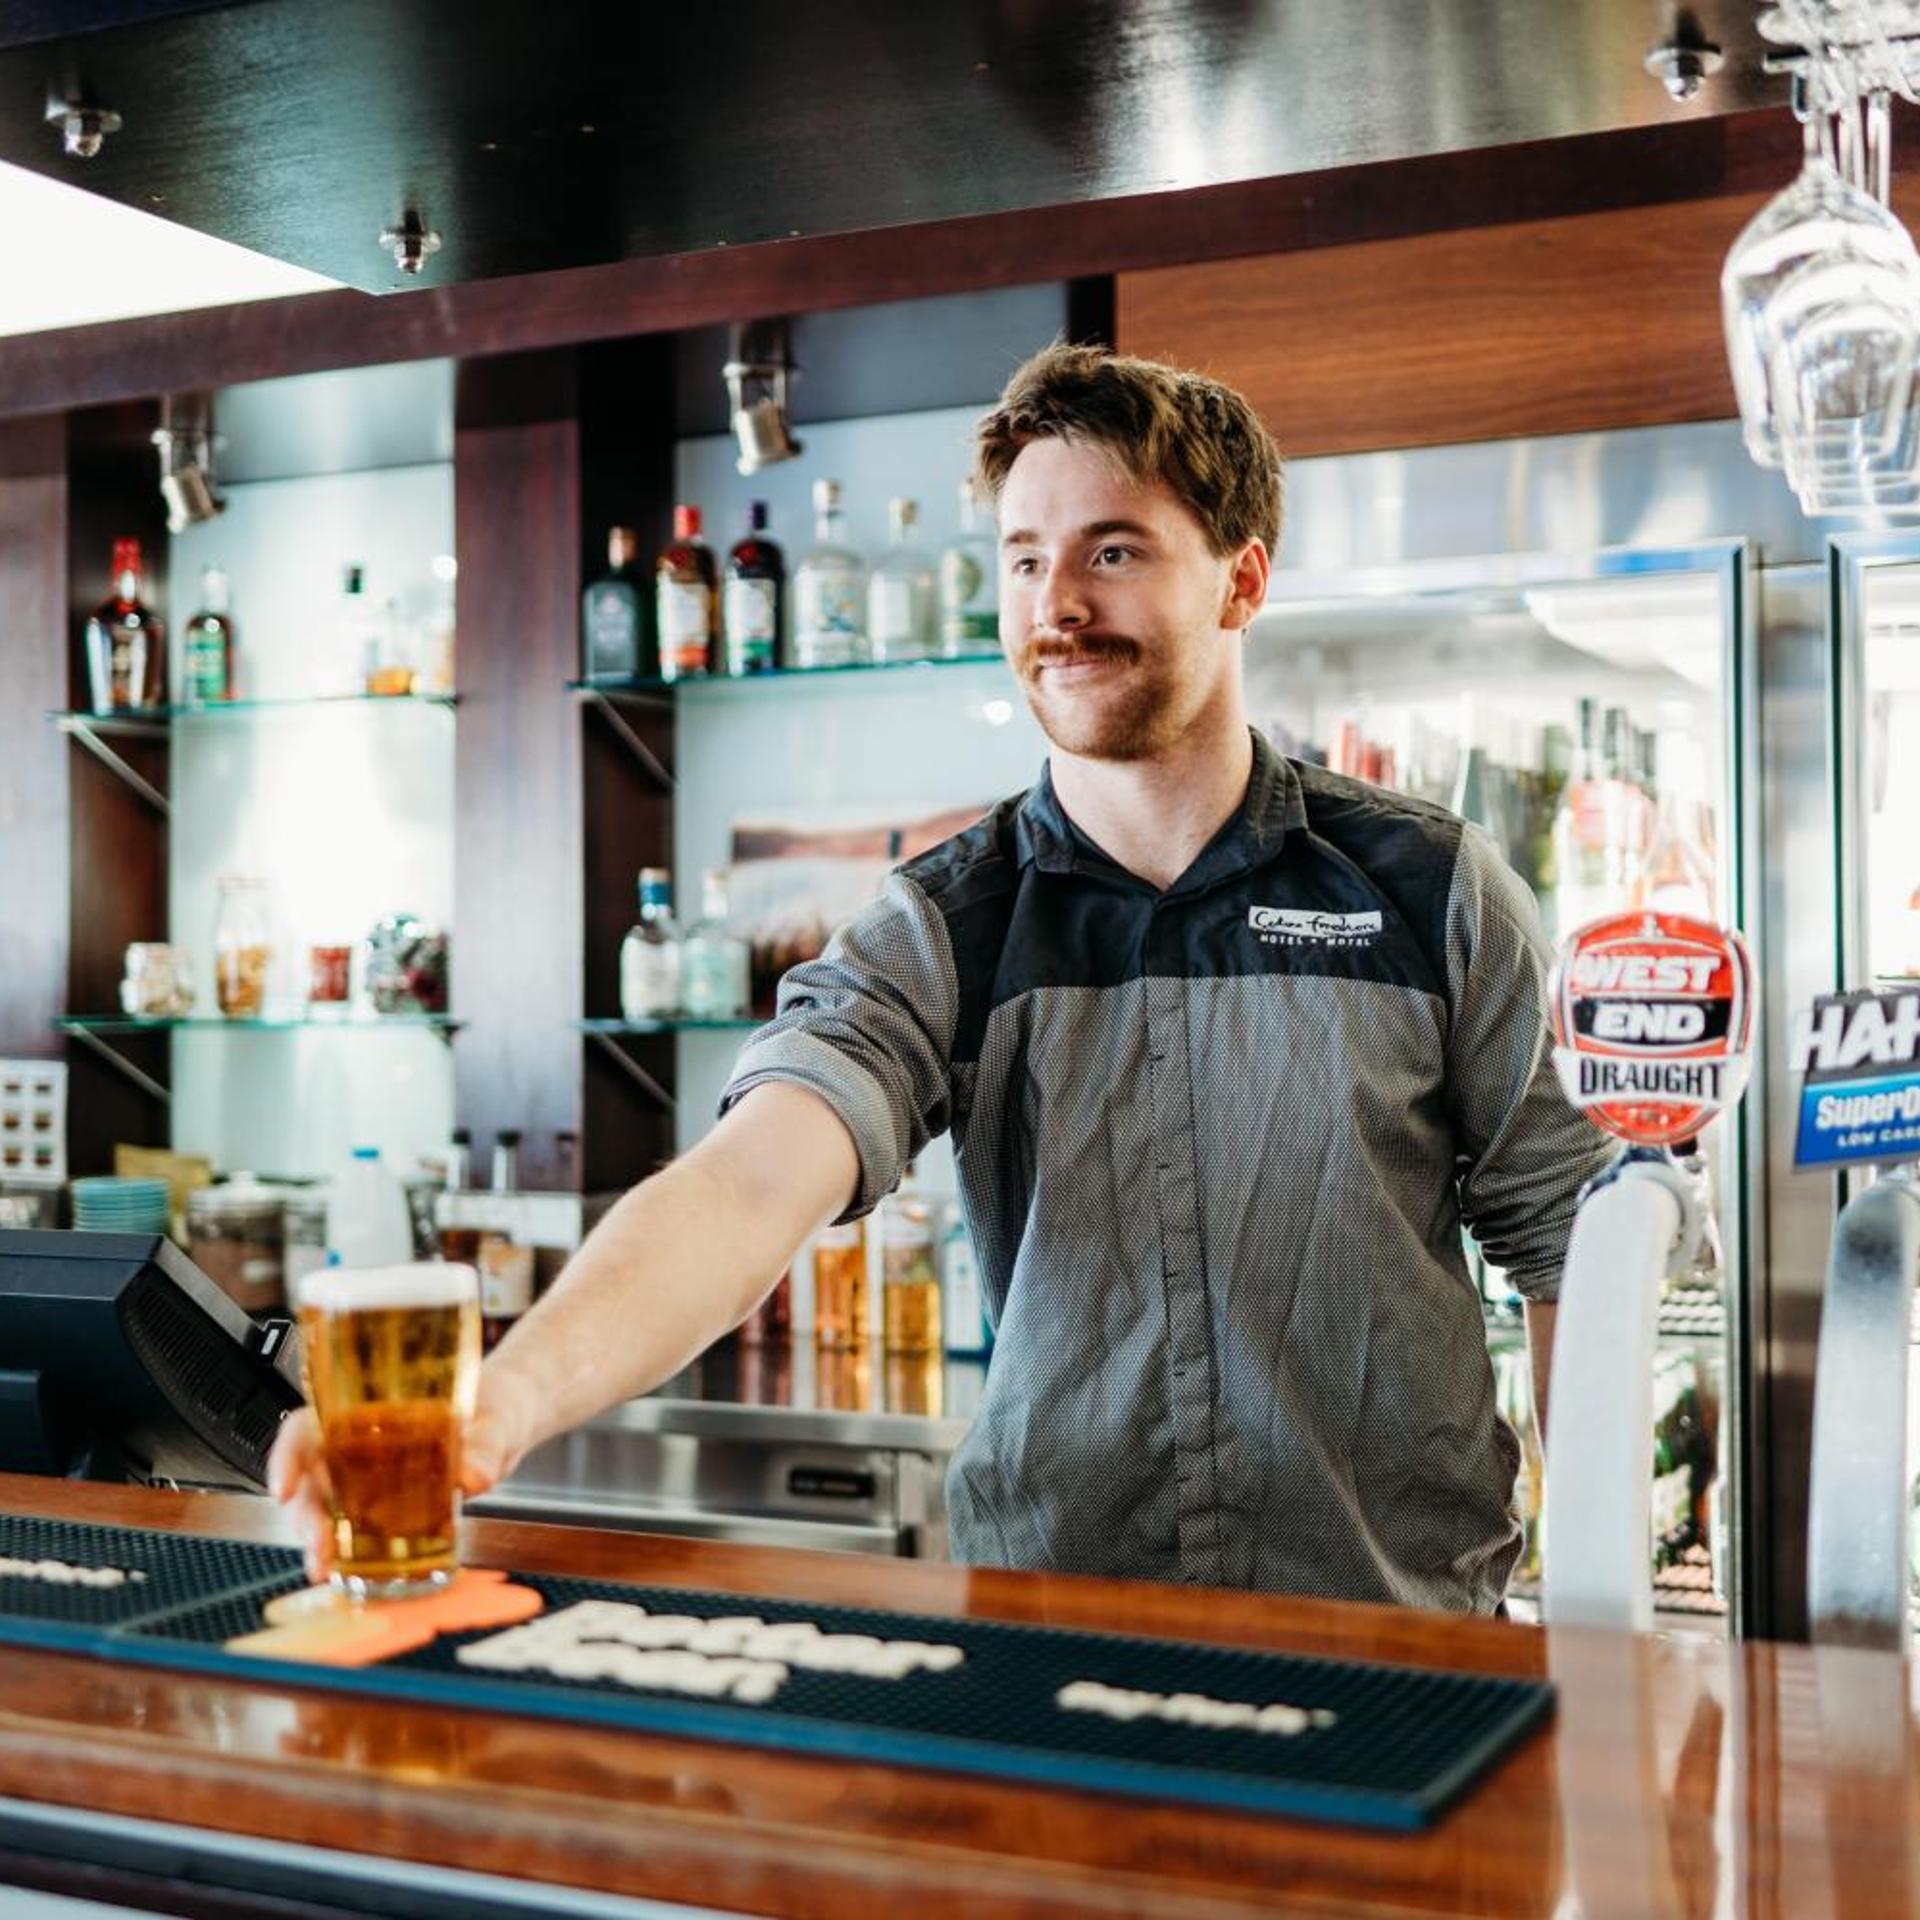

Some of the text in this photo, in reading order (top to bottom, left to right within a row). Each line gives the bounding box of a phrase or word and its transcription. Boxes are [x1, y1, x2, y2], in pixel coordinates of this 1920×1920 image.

[1260, 933, 1371, 947] HOTEL MOTEL
[1571, 953, 1722, 992] WEST
[1592, 1003, 1706, 1042] END
[1579, 1056, 1727, 1101] DRAUGHT
[1837, 1126, 1920, 1148] LOW CAR
